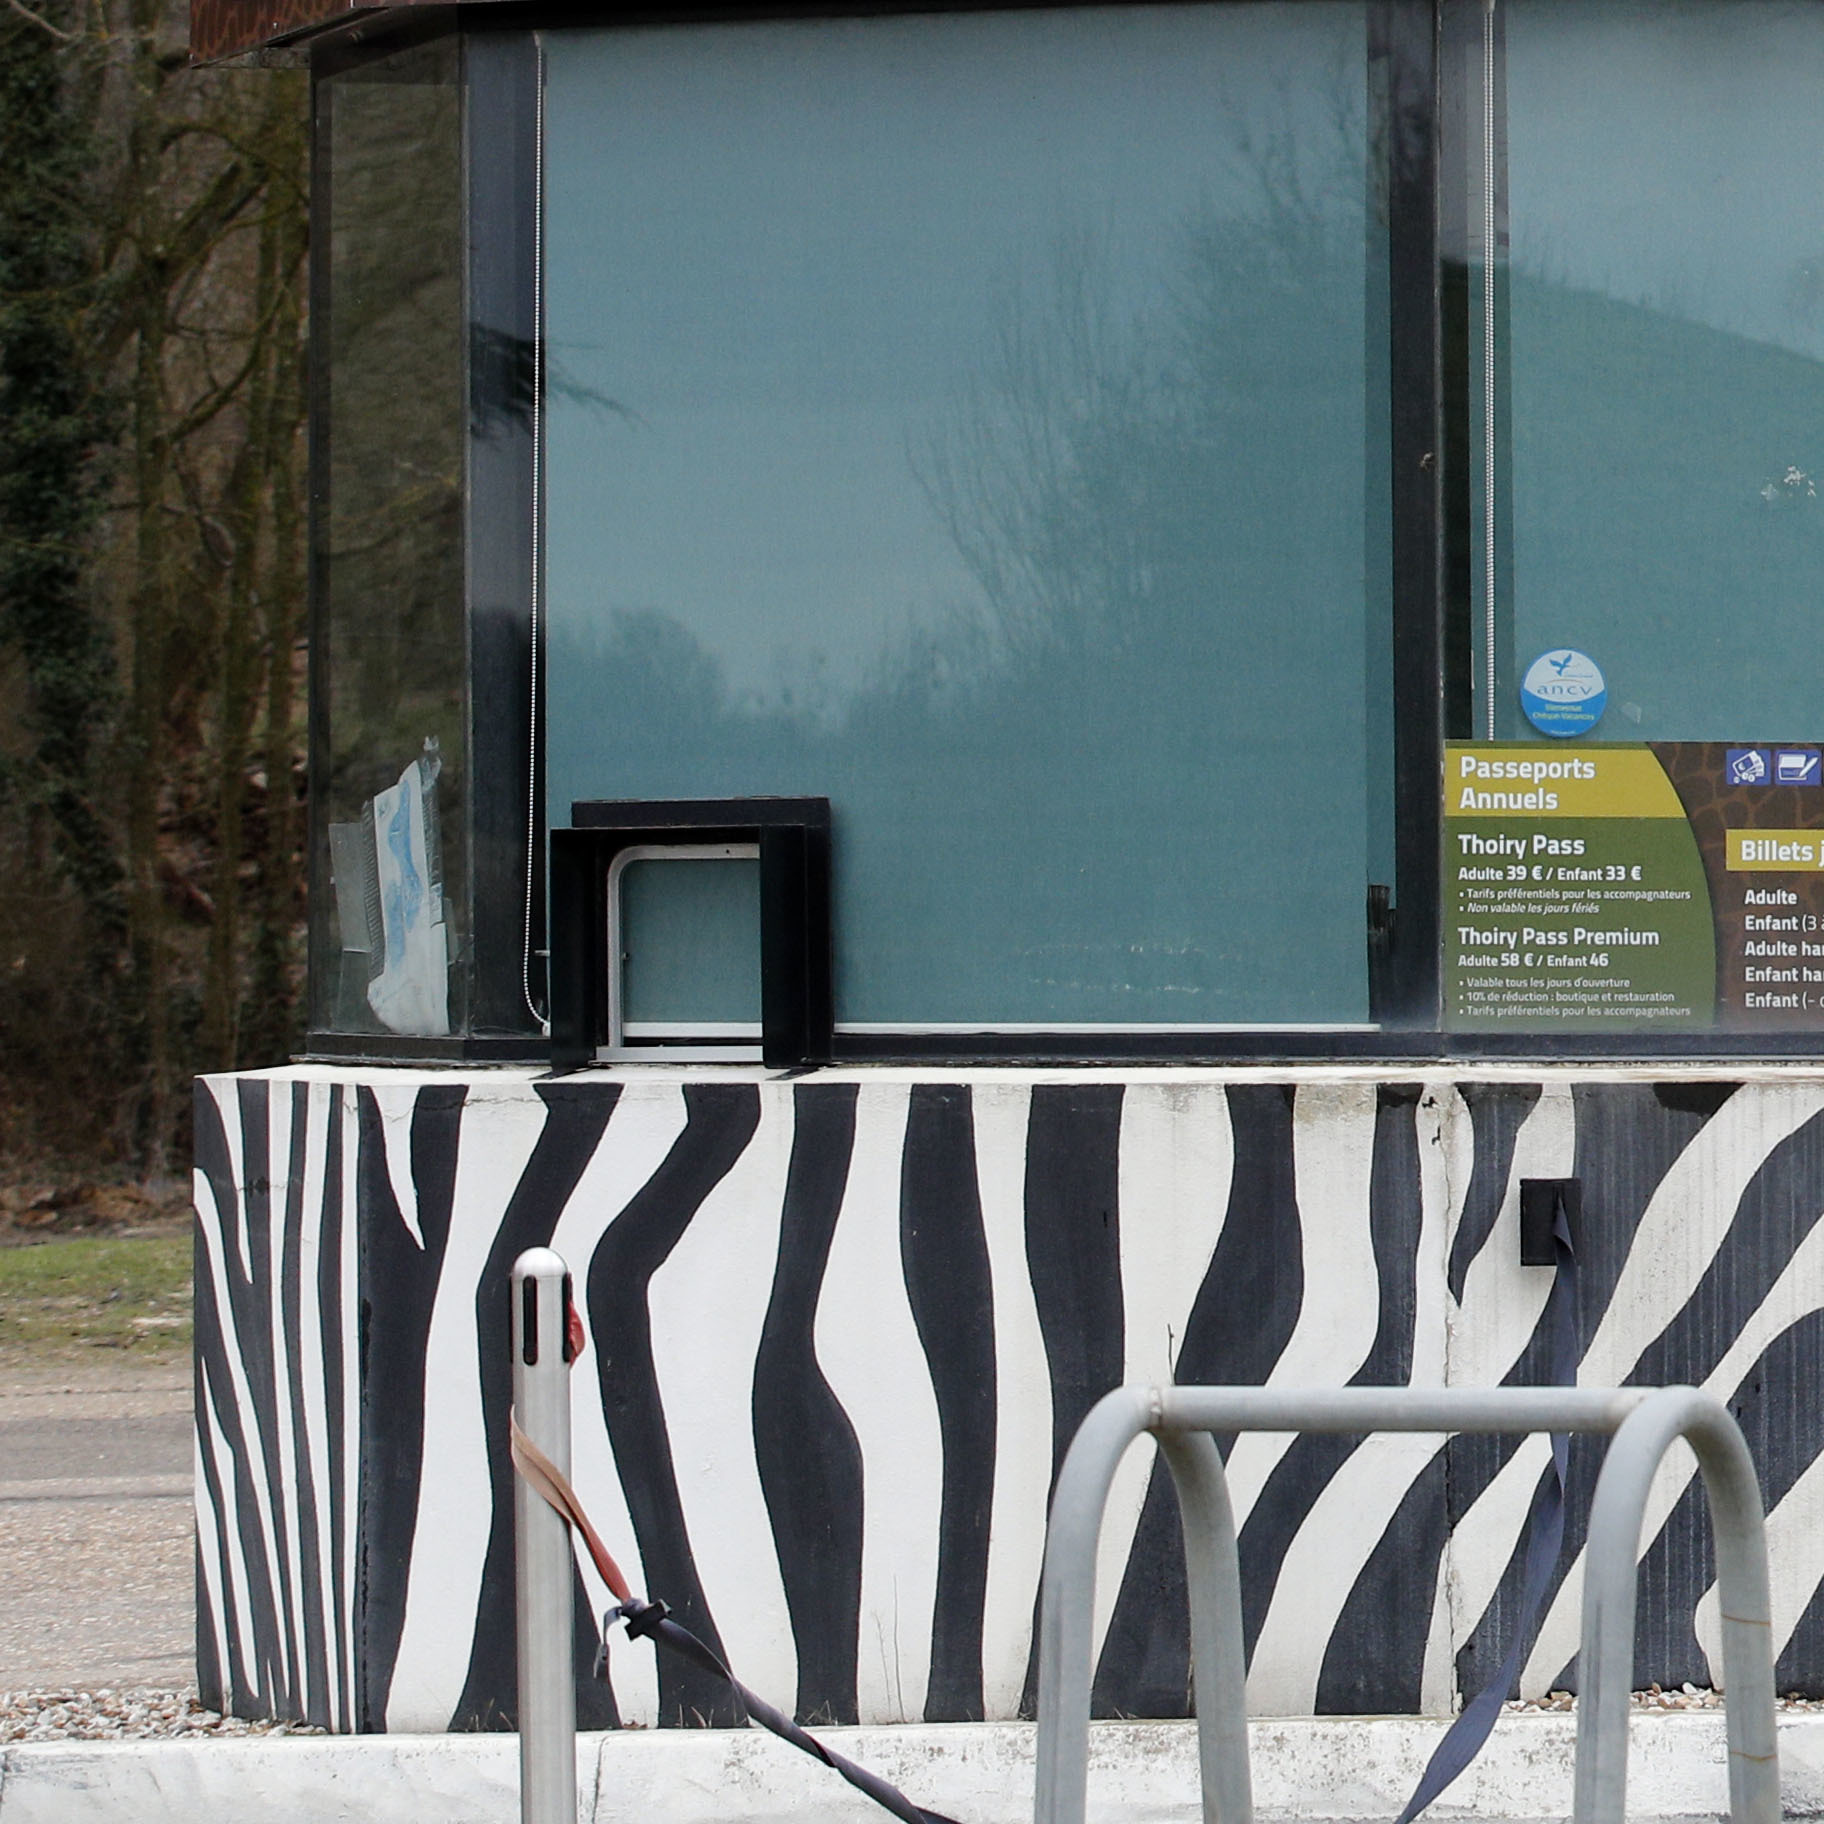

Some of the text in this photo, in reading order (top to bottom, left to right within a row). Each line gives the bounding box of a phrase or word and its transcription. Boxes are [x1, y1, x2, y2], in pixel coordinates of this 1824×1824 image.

[1537, 685, 1592, 695] ancv
[1460, 756, 1595, 783] Passeports
[1460, 787, 1558, 809] Annuels
[1458, 834, 1584, 859] Thoiry Pass
[1741, 841, 1813, 861] Billets
[1458, 867, 1503, 880] Adulte
[1506, 866, 1526, 880] 39
[1532, 866, 1542, 880] €
[1558, 868, 1602, 880] Enfant
[1606, 866, 1627, 880] 33
[1631, 866, 1641, 880] €
[1467, 888, 1690, 901] Tarifs préférentiels pour les accompagnateurs
[1745, 889, 1797, 905] Adulte
[1468, 902, 1599, 914] Non valable les jours fériés
[1745, 915, 1798, 930] Enfant
[1802, 915, 1817, 932] (3
[1458, 928, 1659, 949] Thoiry Pass Premium
[1745, 941, 1797, 956] Adulte
[1458, 955, 1498, 966] Adulte
[1501, 953, 1519, 966] 58
[1524, 953, 1533, 966] €
[1547, 955, 1587, 966] Enfant
[1590, 953, 1608, 966] 46
[1745, 967, 1798, 982] Enfant
[1467, 978, 1630, 989] Valable tous les jours d'ouverture
[1467, 992, 1486, 1001] 10%
[1488, 992, 1500, 1001] de
[1503, 992, 1548, 1001] réduction
[1556, 992, 1599, 1003] boutique
[1602, 993, 1612, 1001] et
[1615, 992, 1674, 1001] restauration
[1745, 993, 1798, 1008] Enfant
[1467, 1005, 1690, 1018] Tarifs préférentiels pour les accompagnateurs
